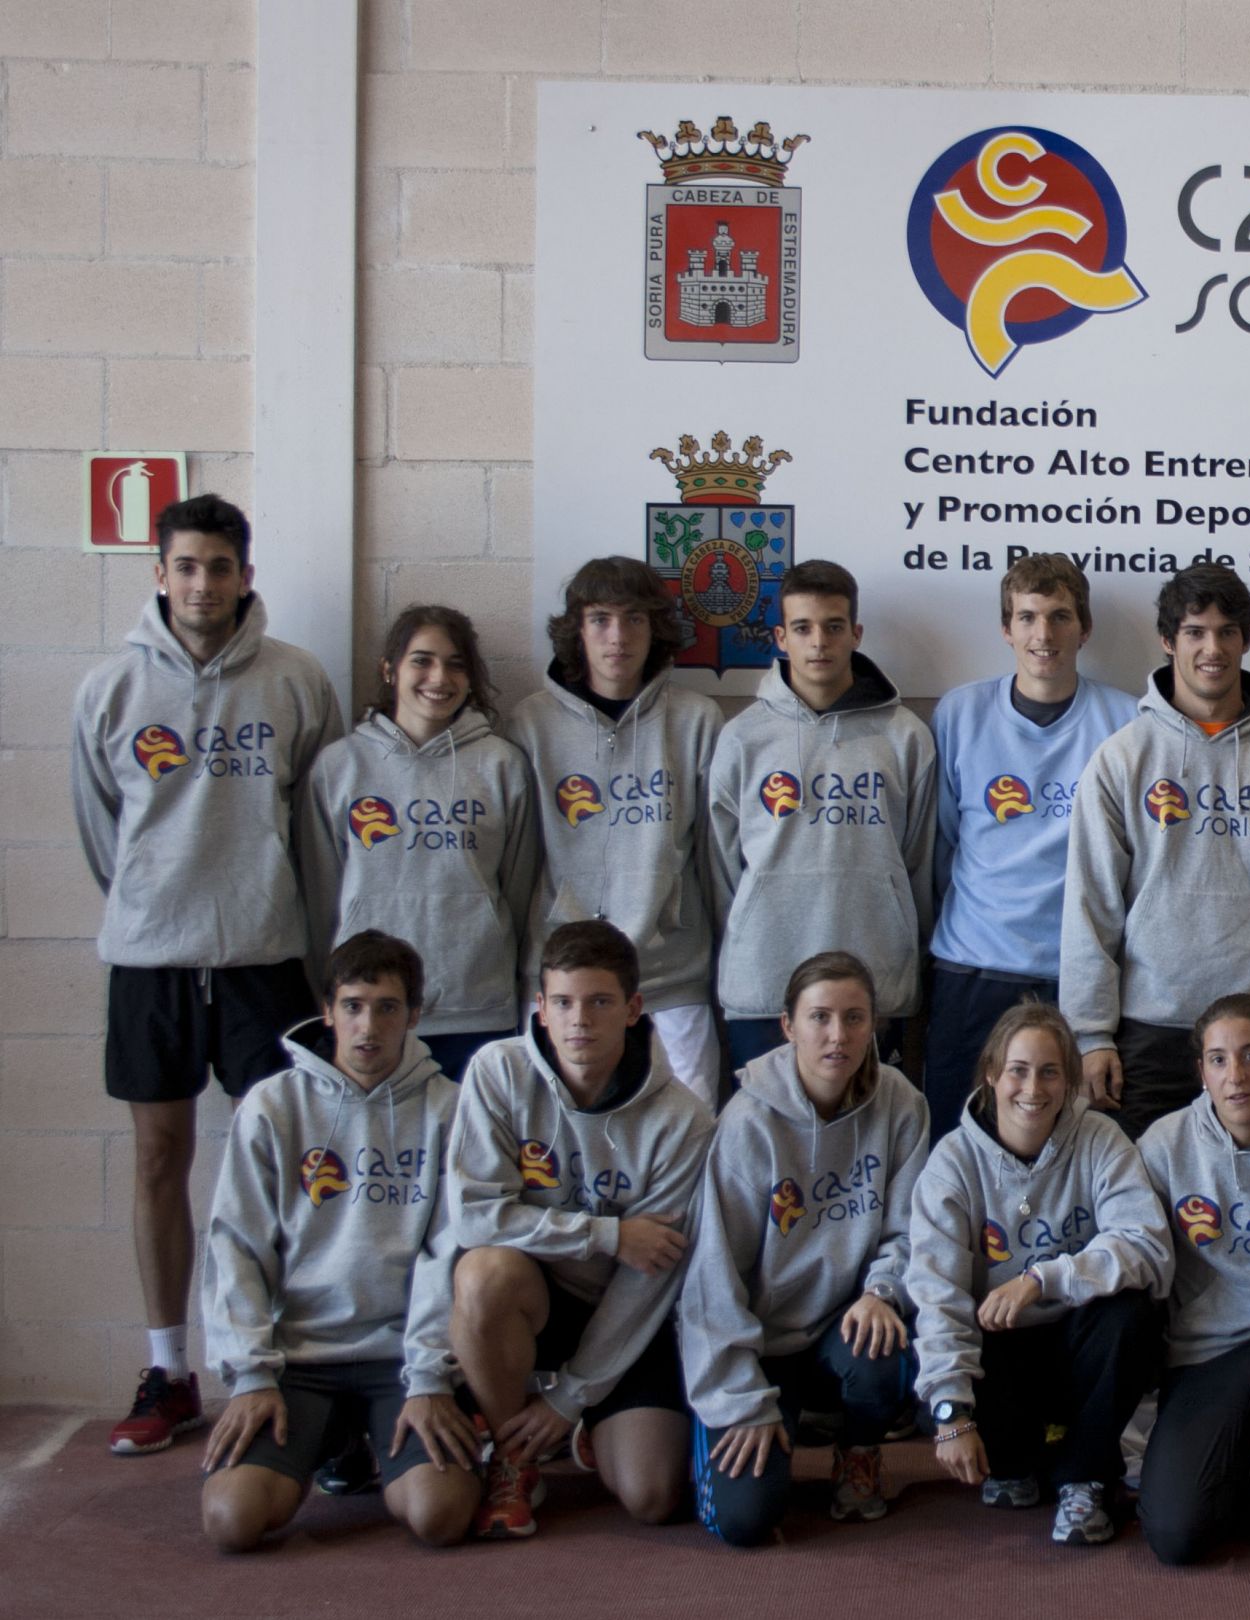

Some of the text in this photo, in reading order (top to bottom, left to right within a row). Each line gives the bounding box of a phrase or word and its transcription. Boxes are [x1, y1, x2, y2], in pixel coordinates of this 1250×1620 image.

[672, 189, 780, 205] CABEZA DE
[649, 213, 663, 329] SORIA PURA
[782, 212, 798, 347] ESTREMADURA
[906, 398, 1098, 428] Fundación
[904, 446, 1036, 476] Centro
[1047, 449, 1131, 477] Alto
[903, 501, 925, 530] y
[938, 495, 1141, 525] Promoción
[689, 541, 725, 564] CABEZA
[728, 543, 742, 555] DE
[903, 543, 949, 571] de
[961, 544, 993, 572] la
[1006, 544, 1178, 574] Pvincia
